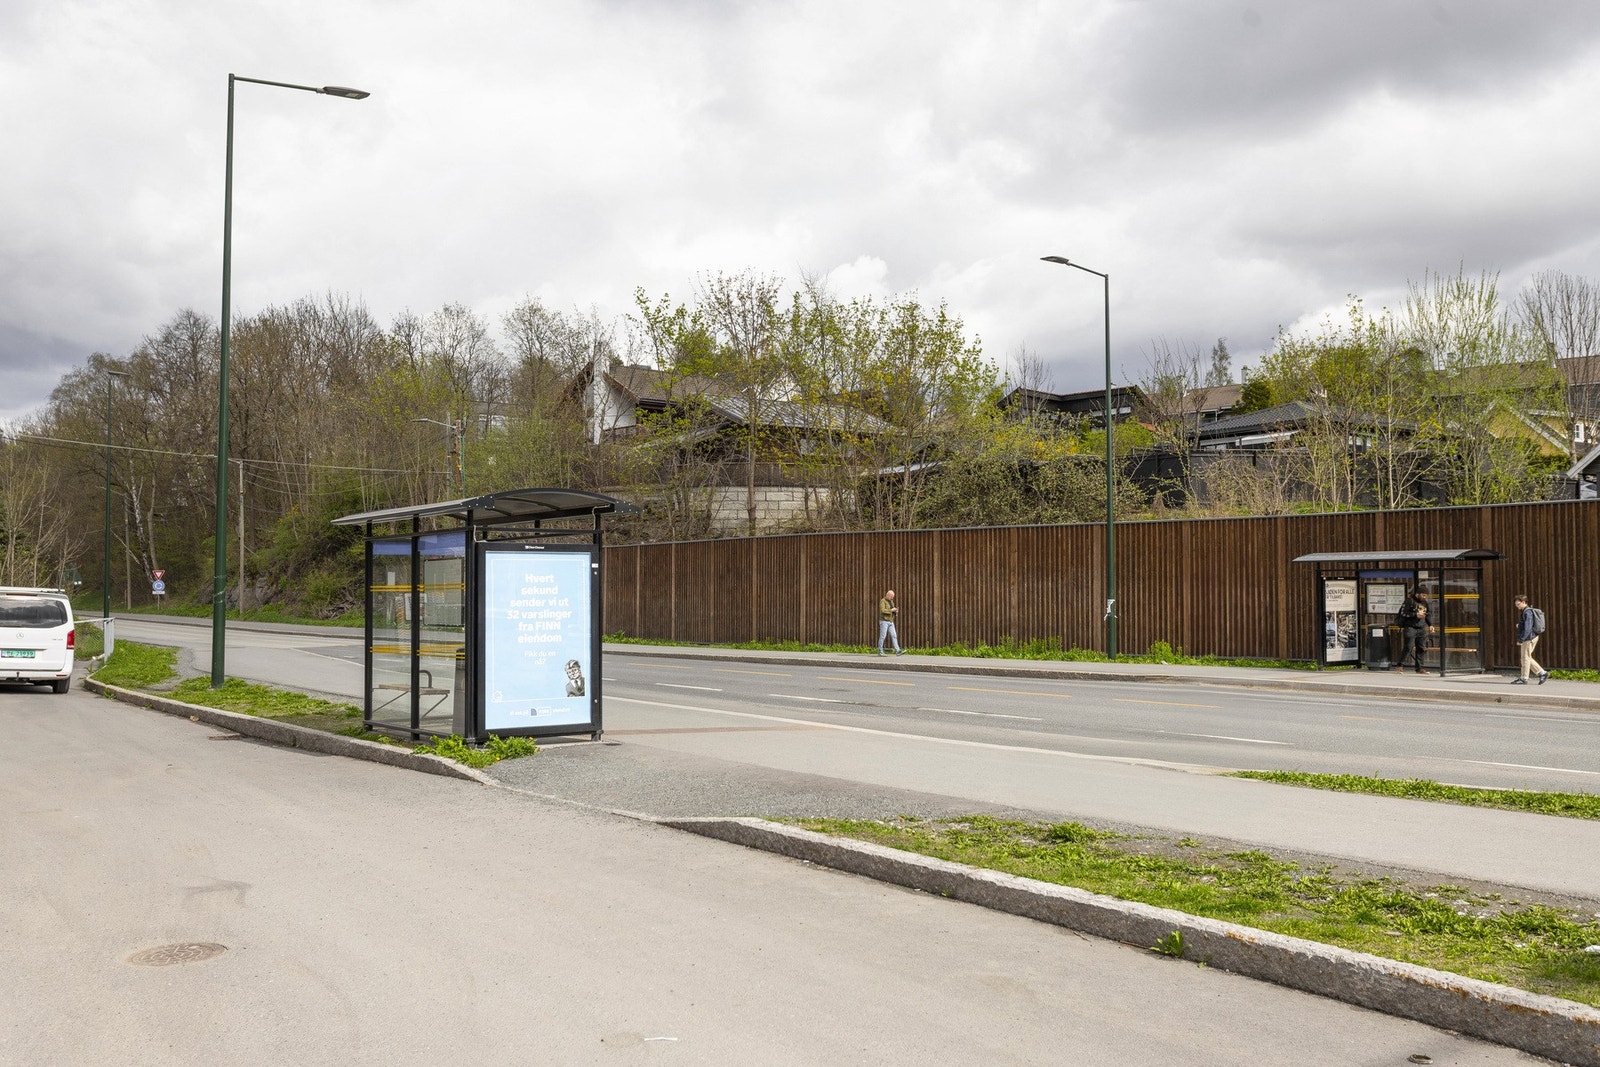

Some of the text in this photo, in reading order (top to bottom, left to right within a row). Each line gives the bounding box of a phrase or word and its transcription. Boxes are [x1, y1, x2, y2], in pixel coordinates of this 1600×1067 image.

[525, 573, 554, 583] Hvert
[521, 585, 558, 595] sekund
[510, 597, 569, 607] sender vi ut
[521, 609, 573, 621] varslinger
[518, 621, 561, 631] fra FINN
[517, 633, 562, 644] eiendom
